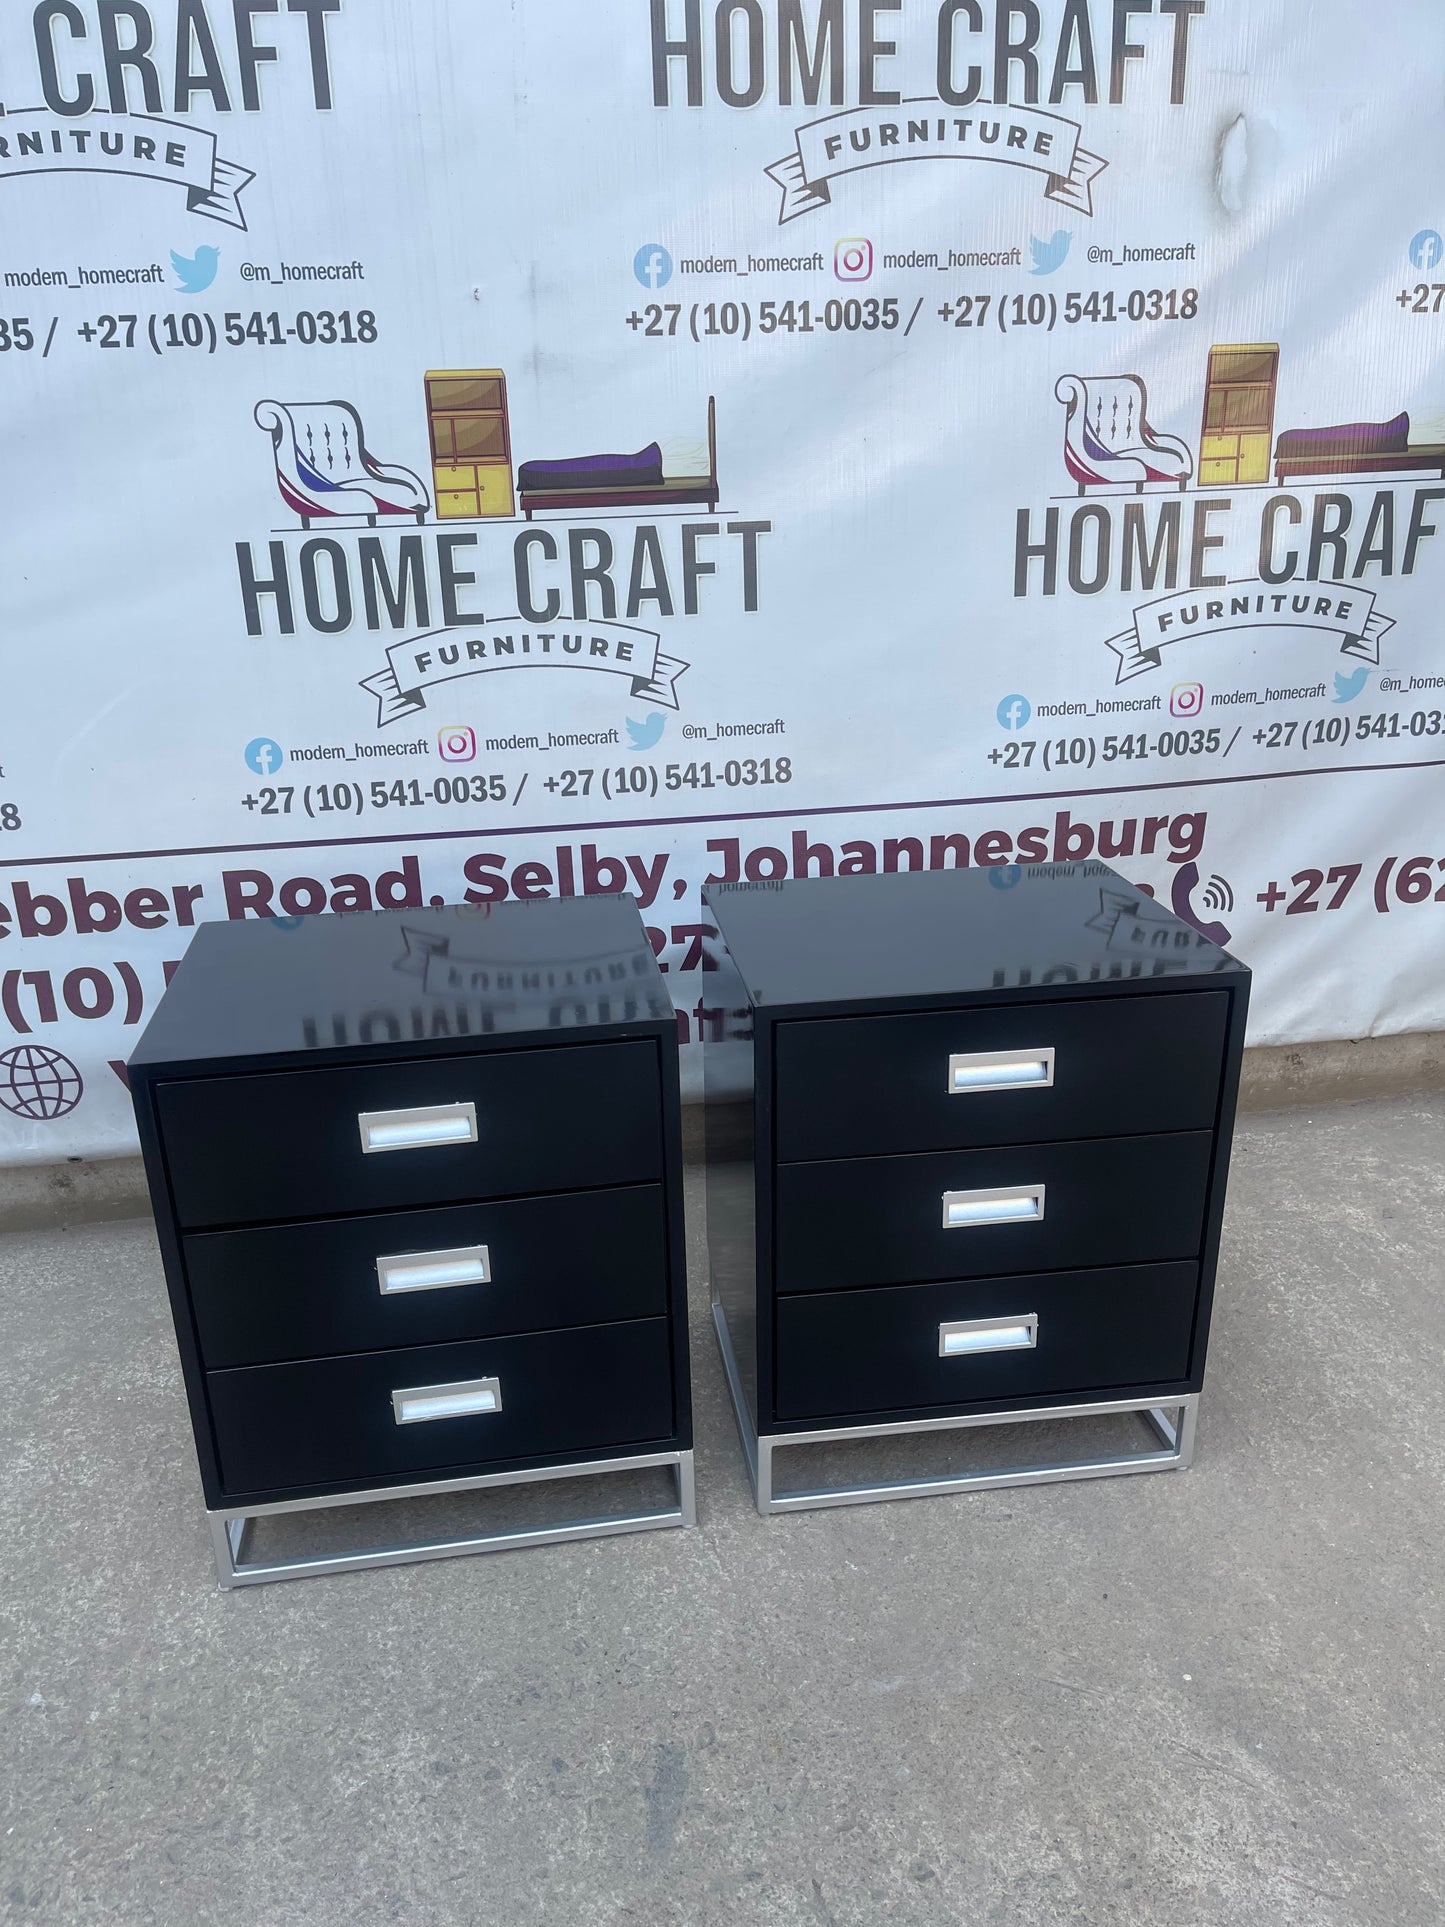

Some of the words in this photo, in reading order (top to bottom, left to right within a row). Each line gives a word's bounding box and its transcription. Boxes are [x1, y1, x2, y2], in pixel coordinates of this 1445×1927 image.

[33, 0, 341, 117] CRAFT
[651, 0, 901, 108] HOME
[936, 0, 1205, 107] CRAFT
[824, 119, 1056, 160] FURNITURE
[240, 261, 365, 284] @m_homecraft
[1087, 243, 1196, 266] @m_homecraft
[625, 304, 681, 337] +27
[690, 302, 751, 342] (10)
[759, 298, 899, 334] 541-0035
[937, 296, 990, 329] +27
[999, 294, 1056, 332] (10)
[1064, 288, 1198, 323] 541-0318
[1396, 283, 1445, 313] +27
[77, 315, 138, 349] +27
[148, 313, 217, 355] (10)
[225, 310, 378, 346] 541-0318
[1013, 499, 1231, 597] HOME
[1258, 487, 1445, 585] CRAF
[235, 532, 485, 636] HOME
[513, 520, 772, 624] CRAFT
[1158, 595, 1353, 632] FURNITURE
[414, 634, 634, 673] FURNITURE
[1379, 675, 1445, 693] @m_home
[682, 719, 785, 741] @m_homecraft
[987, 741, 1037, 769] +27
[1042, 737, 1096, 771] (10)
[1102, 728, 1221, 762] 541-0035
[1252, 721, 1298, 749] +27
[1302, 716, 1350, 750] (10)
[241, 787, 295, 815] +27
[303, 784, 364, 818] (10)
[371, 774, 506, 809] 541-0035
[543, 769, 594, 799] +27
[602, 765, 659, 801] (10)
[665, 756, 793, 790] 541-0318
[0, 877, 204, 940] bber
[463, 843, 688, 909] Selby,
[704, 810, 1207, 864] Johannesburg
[1256, 863, 1363, 916] +27
[1, 961, 144, 1034] (10)
